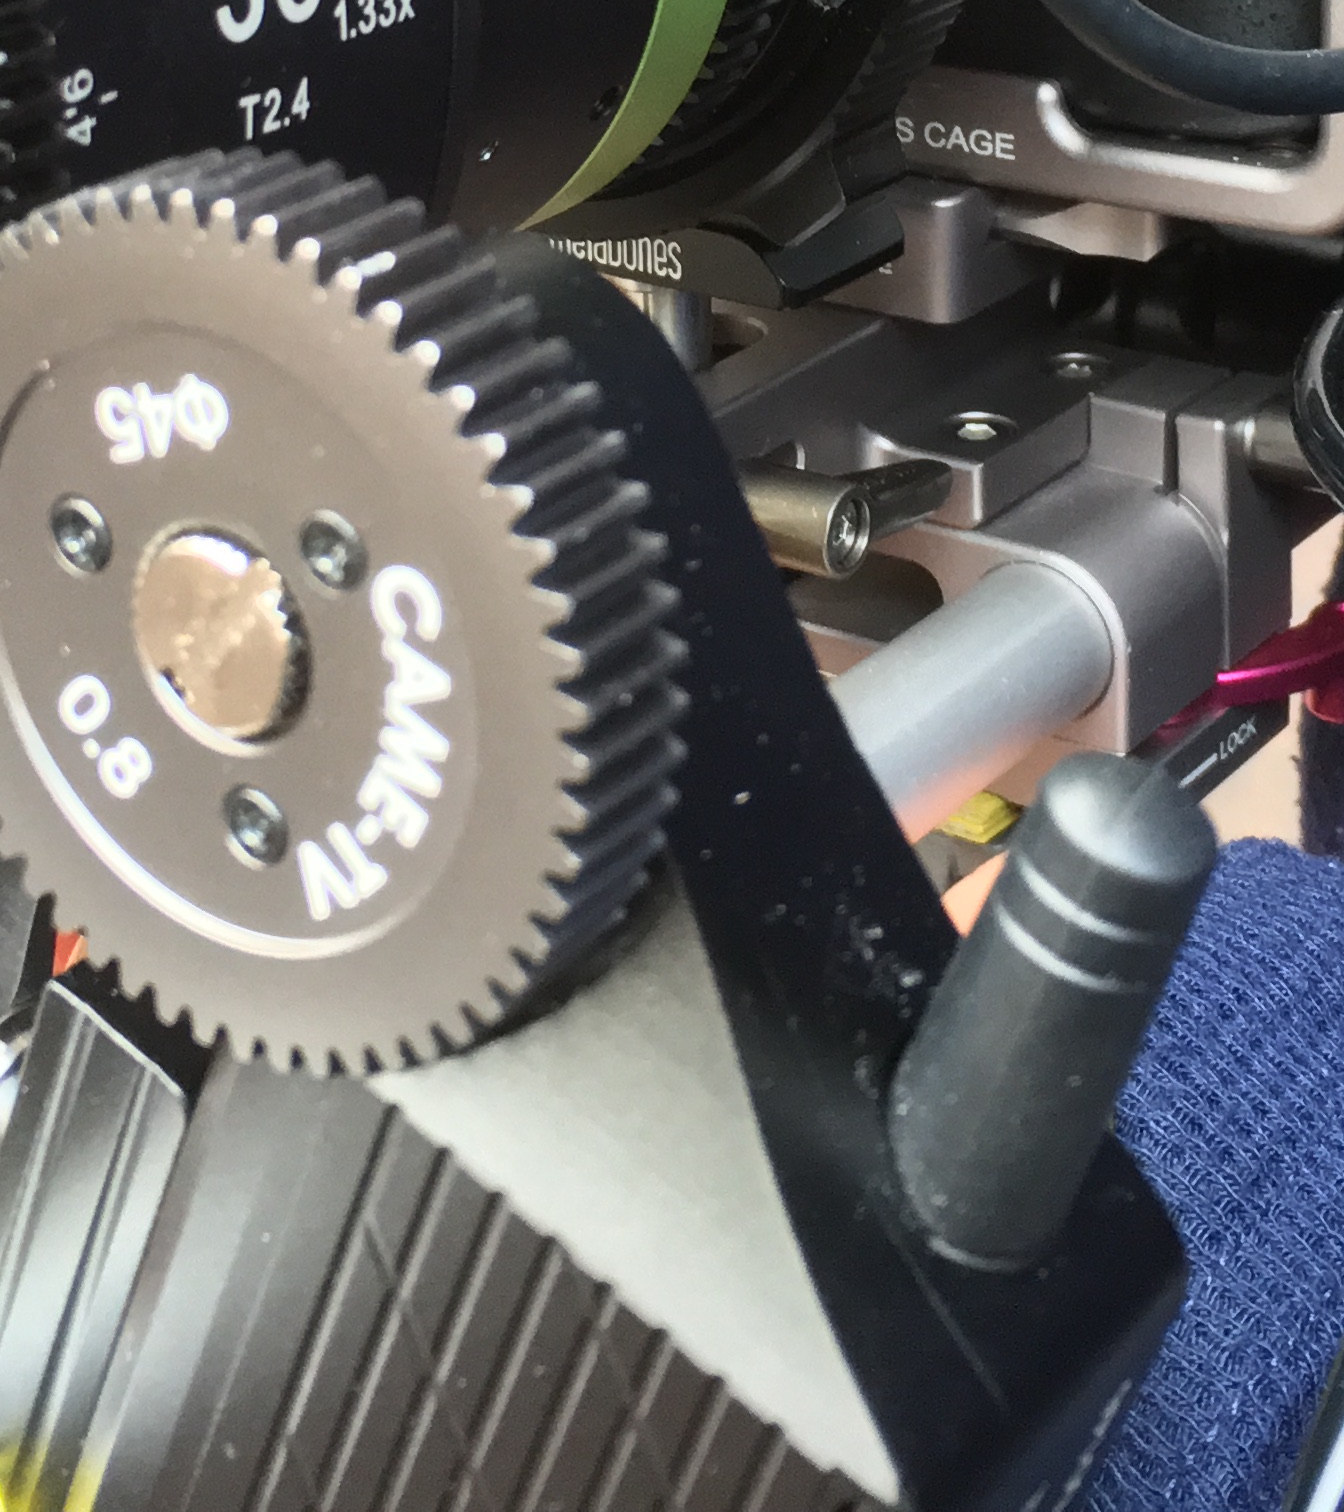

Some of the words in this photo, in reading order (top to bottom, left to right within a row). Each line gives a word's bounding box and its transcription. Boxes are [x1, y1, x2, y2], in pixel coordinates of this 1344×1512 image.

[238, 76, 311, 141] T2.4
[924, 120, 1017, 161] CAGE
[58, 674, 153, 800] 0.8
[1218, 716, 1257, 762] LOCK
